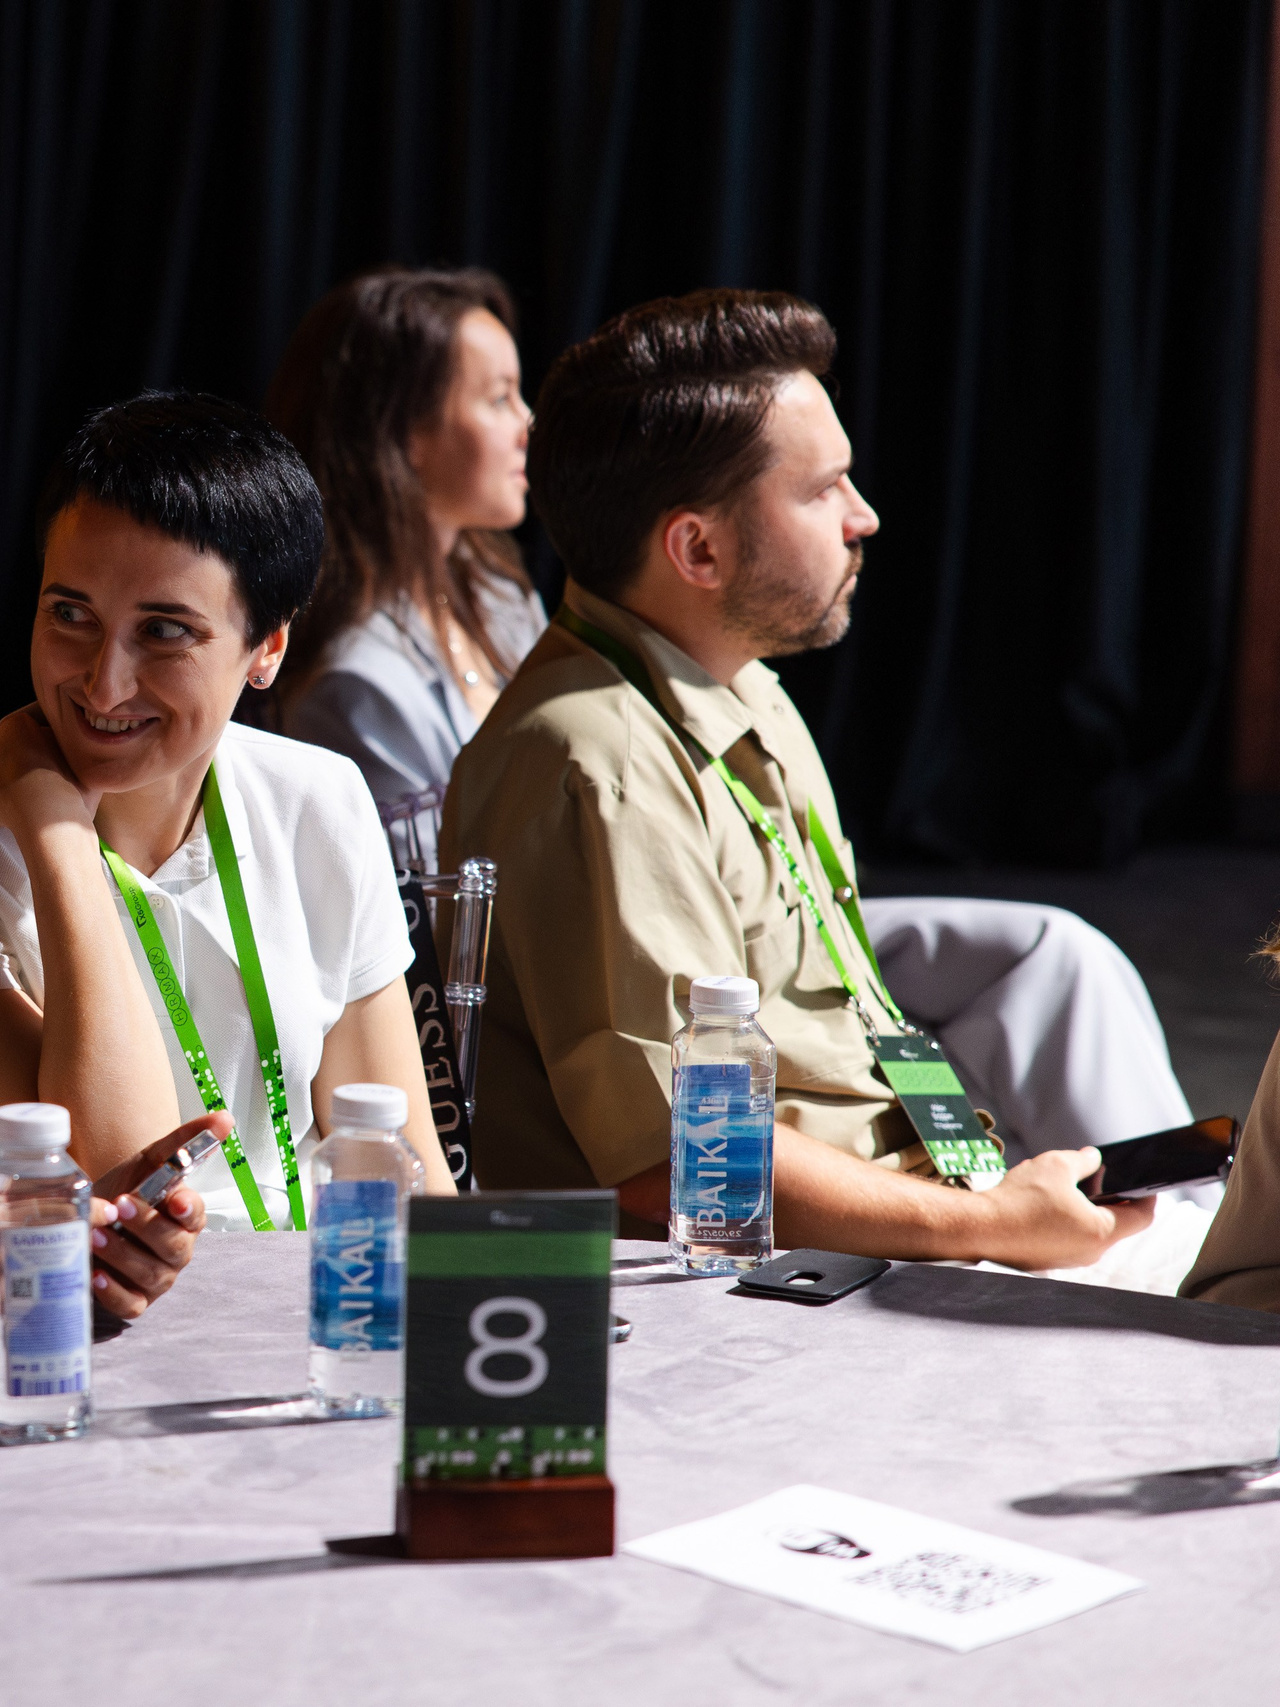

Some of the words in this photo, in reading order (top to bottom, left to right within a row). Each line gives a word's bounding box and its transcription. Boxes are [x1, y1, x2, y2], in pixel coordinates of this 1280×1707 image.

[149, 948, 187, 1025] HRMAX
[696, 1094, 729, 1230] BAIKAL
[338, 1216, 375, 1362] BAIKAL
[464, 1295, 549, 1398] 8
